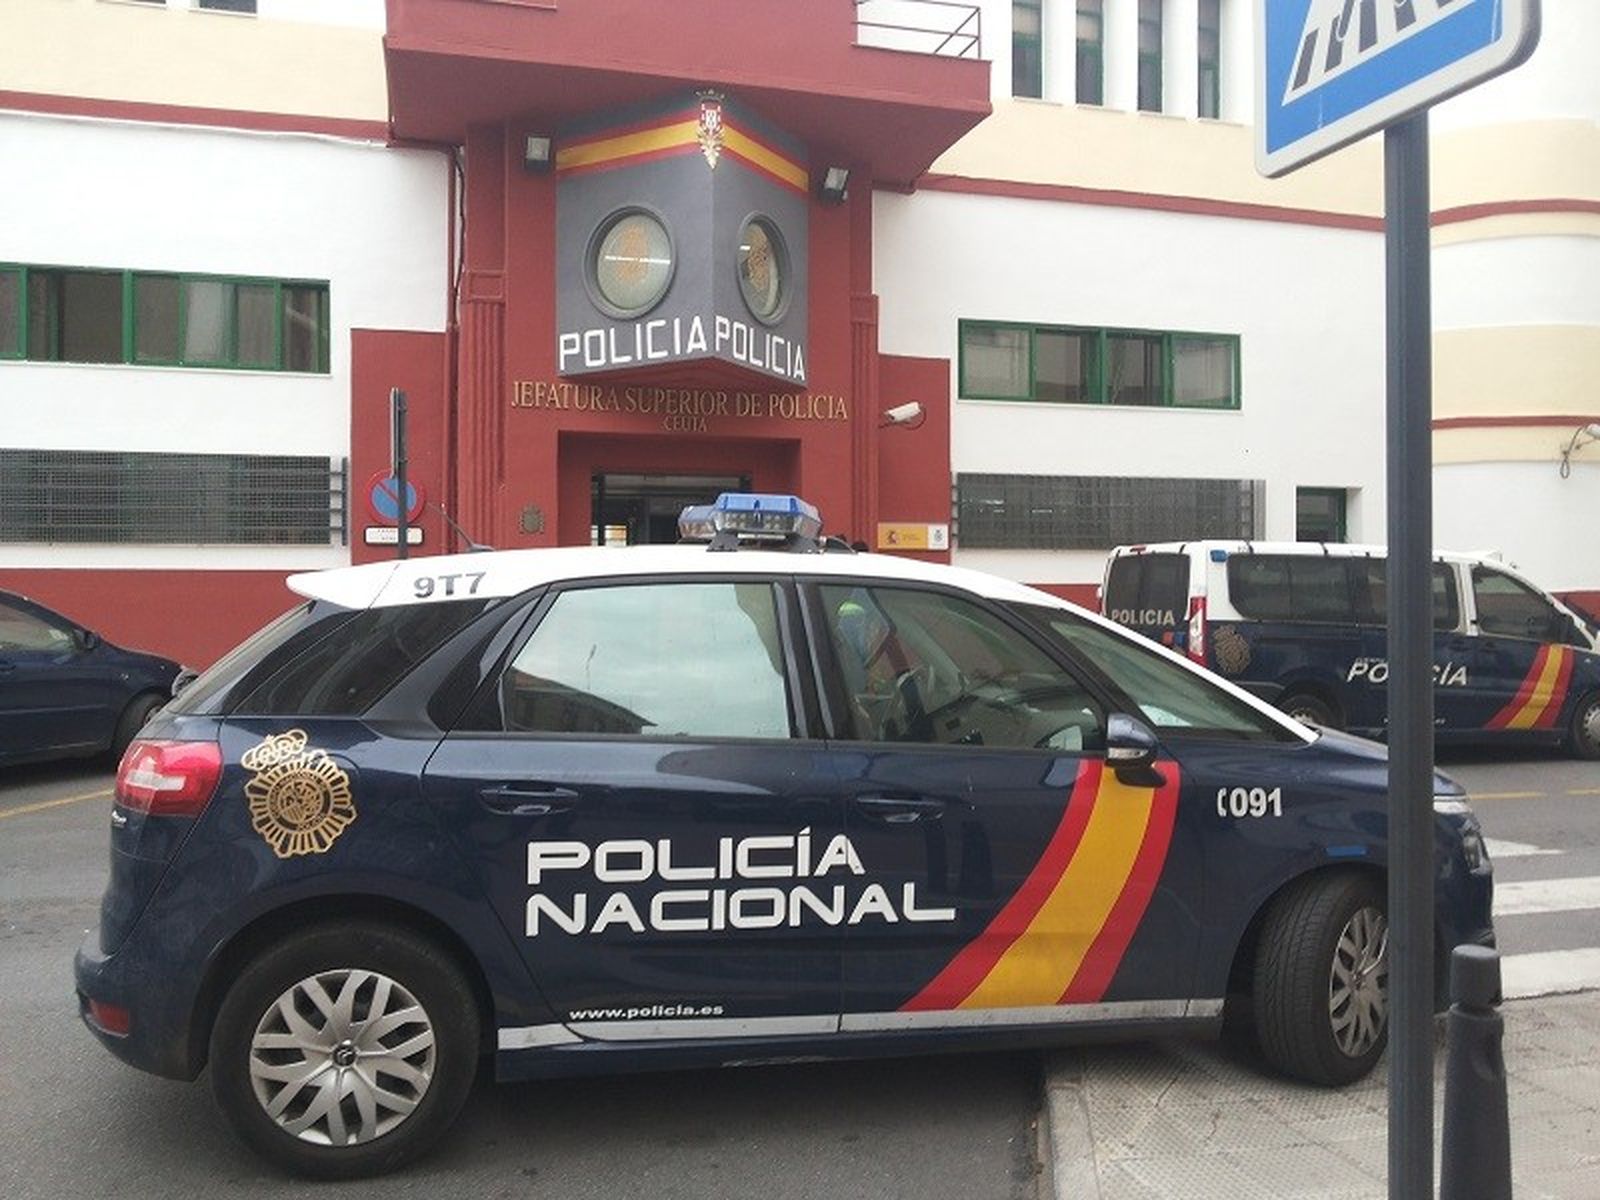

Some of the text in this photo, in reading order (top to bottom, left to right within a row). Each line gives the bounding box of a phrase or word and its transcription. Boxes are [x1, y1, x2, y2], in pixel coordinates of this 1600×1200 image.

[559, 316, 708, 371] POLICIA
[715, 315, 806, 380] POLICIA
[511, 381, 848, 420] JEFATURA SUPERIOR DE POLICIA
[413, 571, 487, 598] 9T7
[1111, 609, 1176, 626] POLICIA
[1346, 661, 1467, 686] POÍA
[1229, 787, 1282, 817] 091
[526, 827, 866, 884] POLICÍA
[525, 882, 956, 936] NACIONAL
[568, 1004, 724, 1019] www.policia.es
